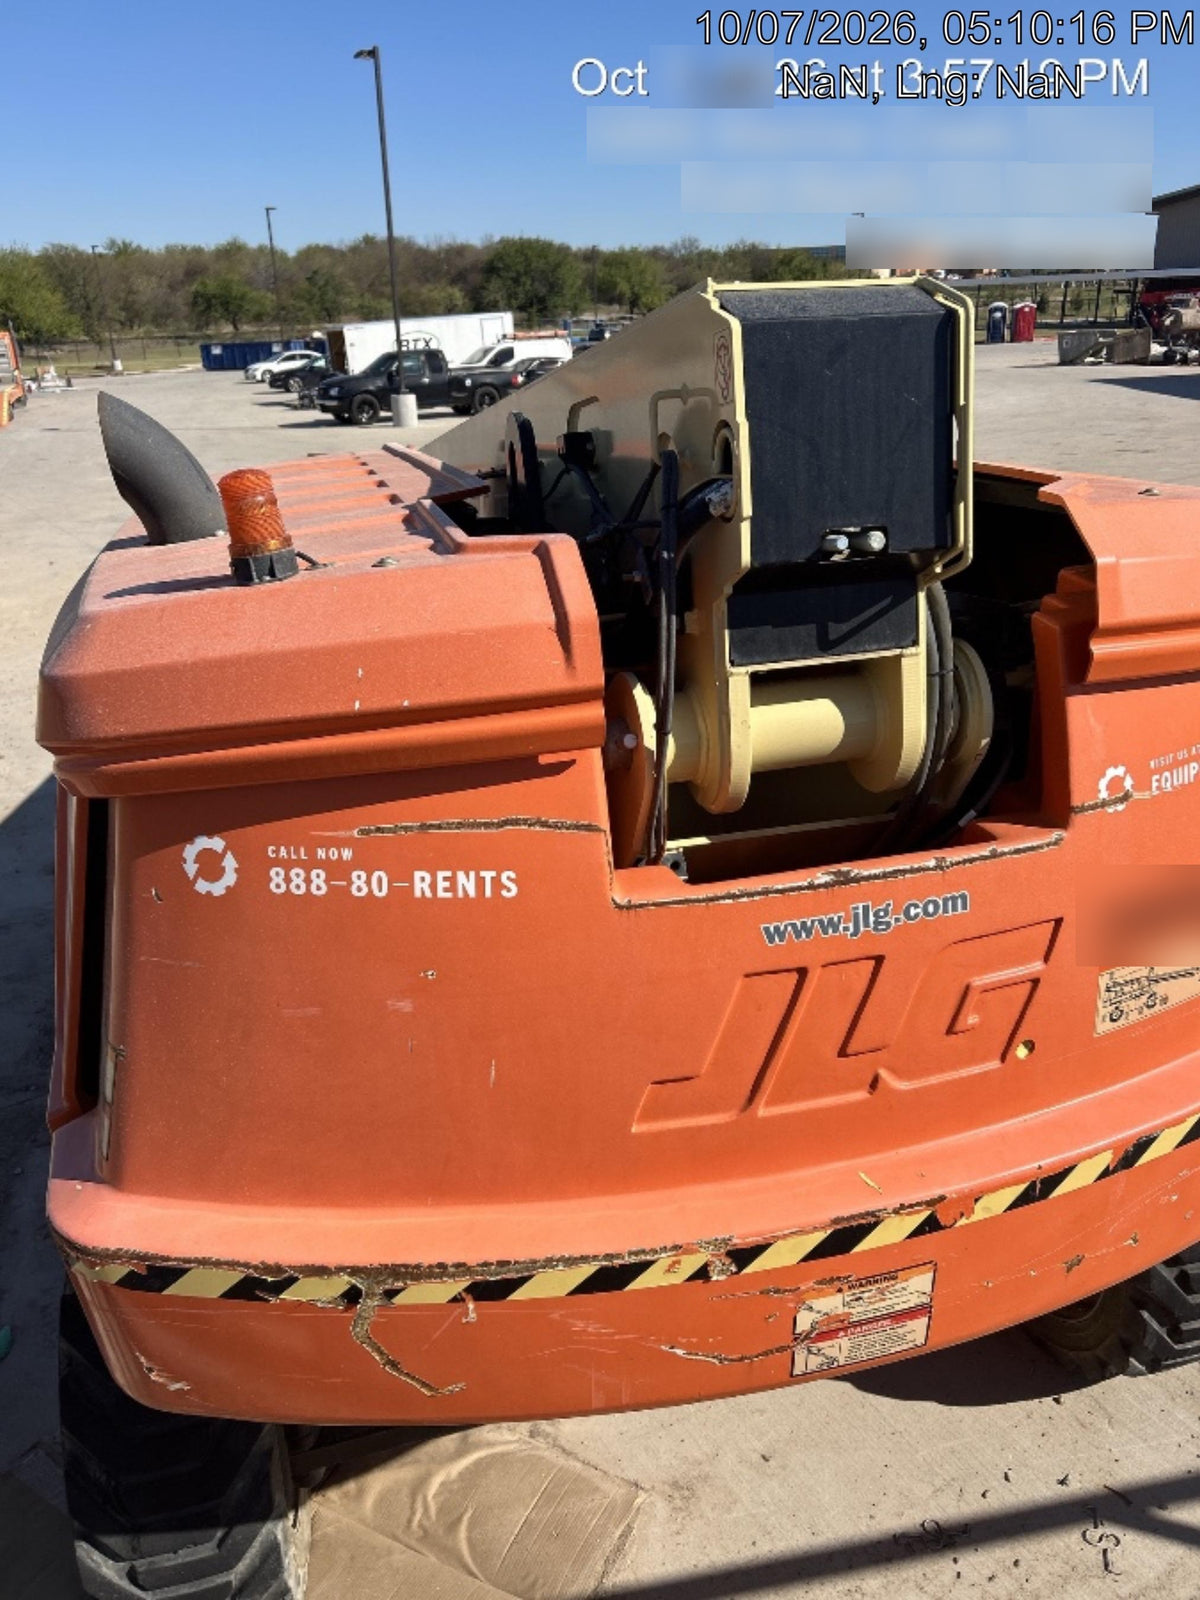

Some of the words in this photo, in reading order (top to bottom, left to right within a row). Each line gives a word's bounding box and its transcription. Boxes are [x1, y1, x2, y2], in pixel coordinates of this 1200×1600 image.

[1151, 761, 1200, 796] EQUIP
[267, 845, 309, 860] CALL
[316, 847, 353, 861] NOW
[269, 866, 519, 899] 888-80-RENTS
[760, 889, 970, 945] www.jlg.com
[631, 916, 1065, 1133] JLG
[847, 1272, 899, 1290] WARNING
